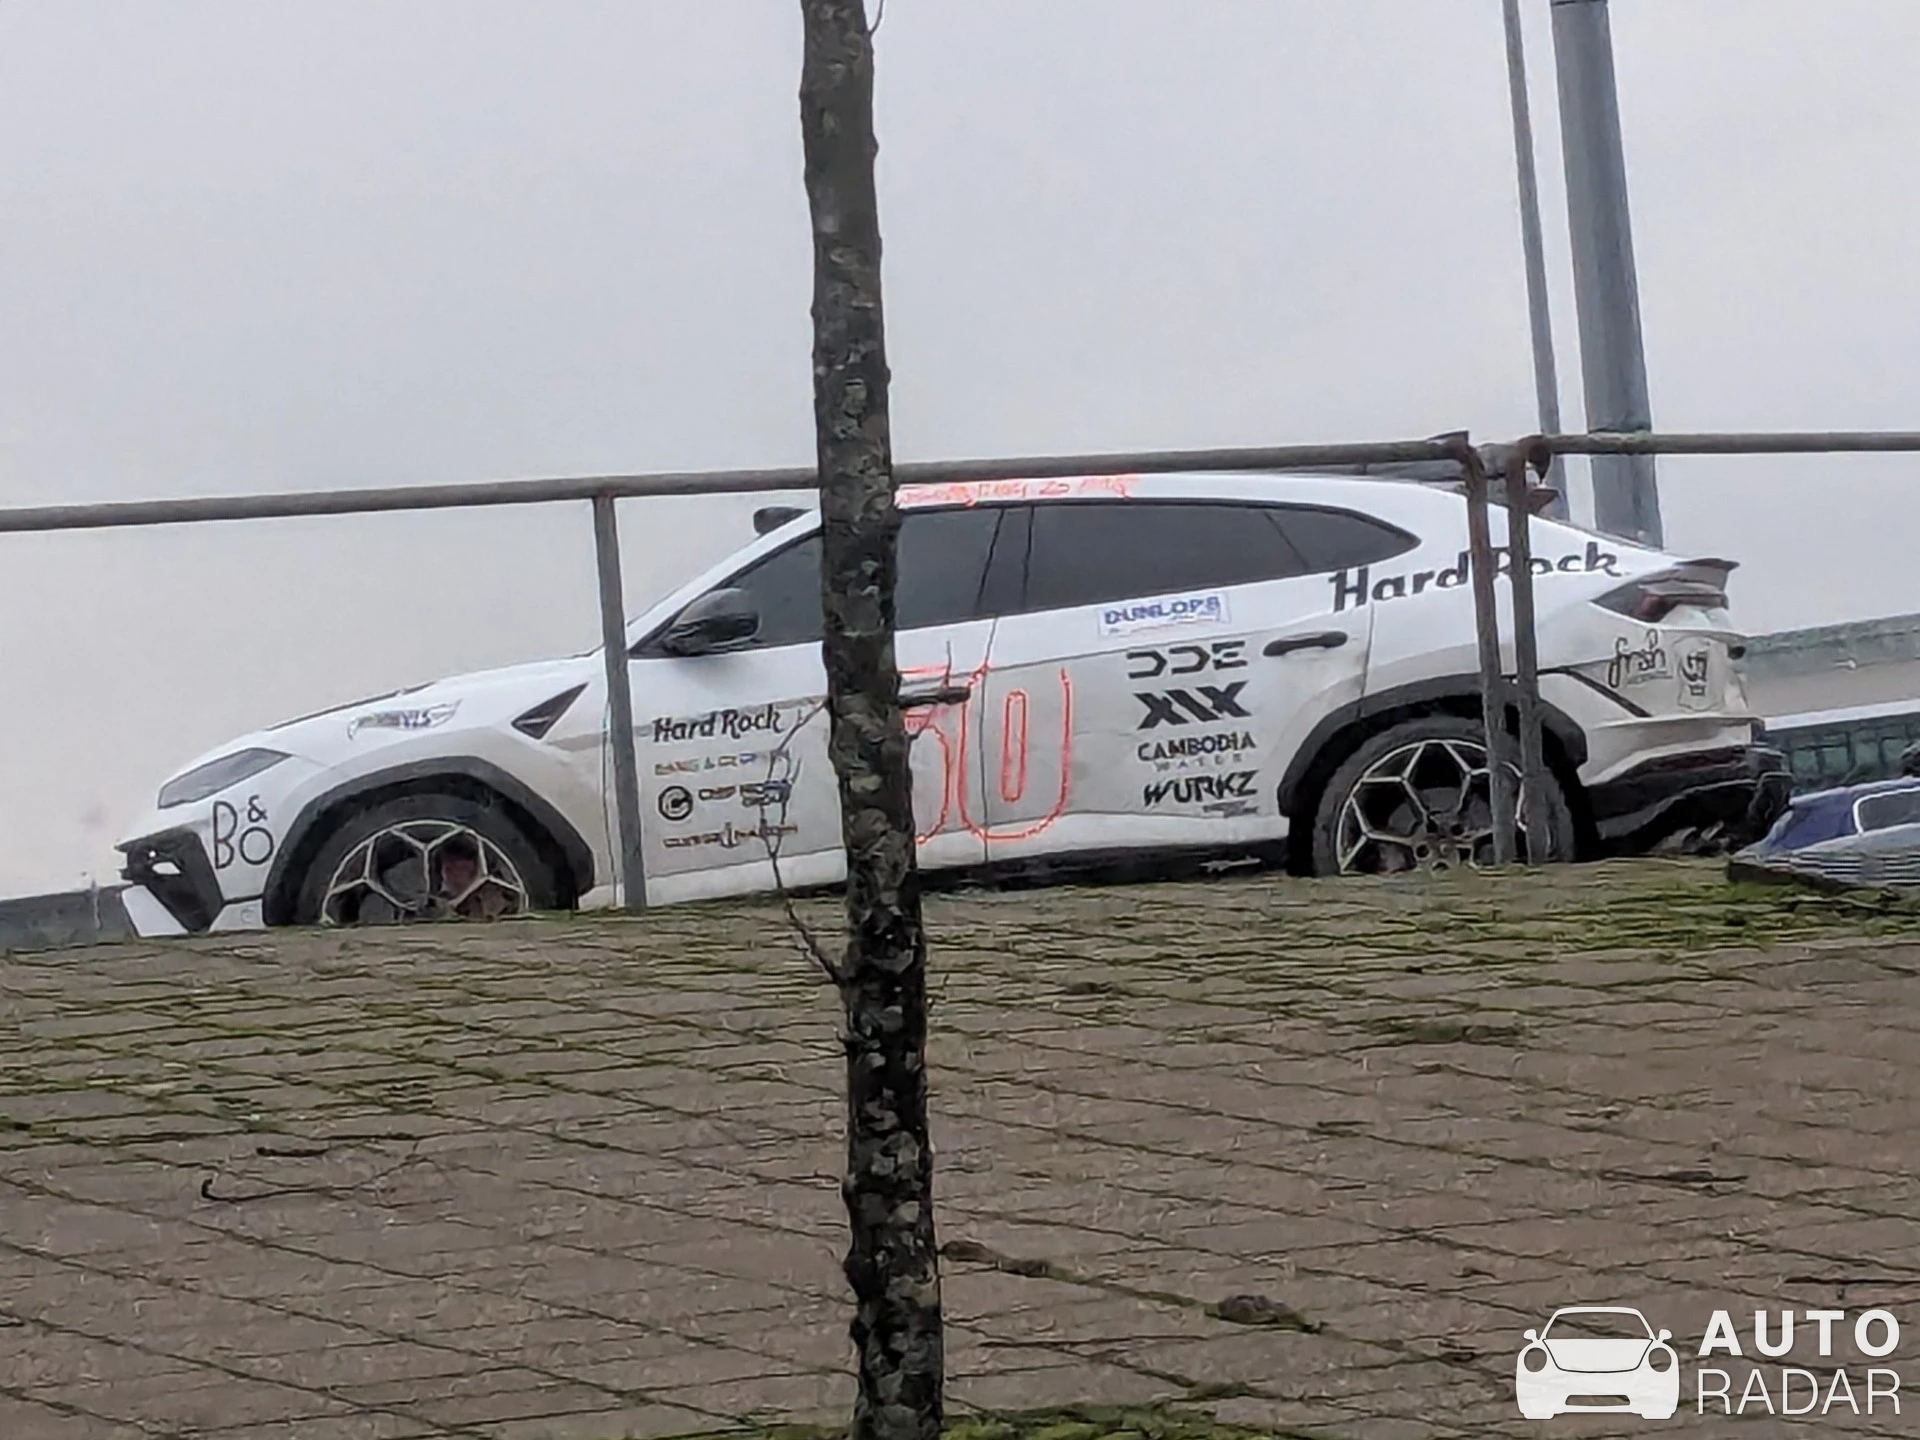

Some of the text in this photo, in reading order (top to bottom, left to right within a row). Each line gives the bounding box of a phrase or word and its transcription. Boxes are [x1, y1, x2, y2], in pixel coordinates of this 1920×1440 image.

[1327, 549, 1470, 612] Hard
[1126, 640, 1248, 679] DDE
[652, 703, 782, 742] Hard Rock
[1137, 731, 1257, 761] CAMBODIA
[1143, 769, 1259, 807] WURKZ
